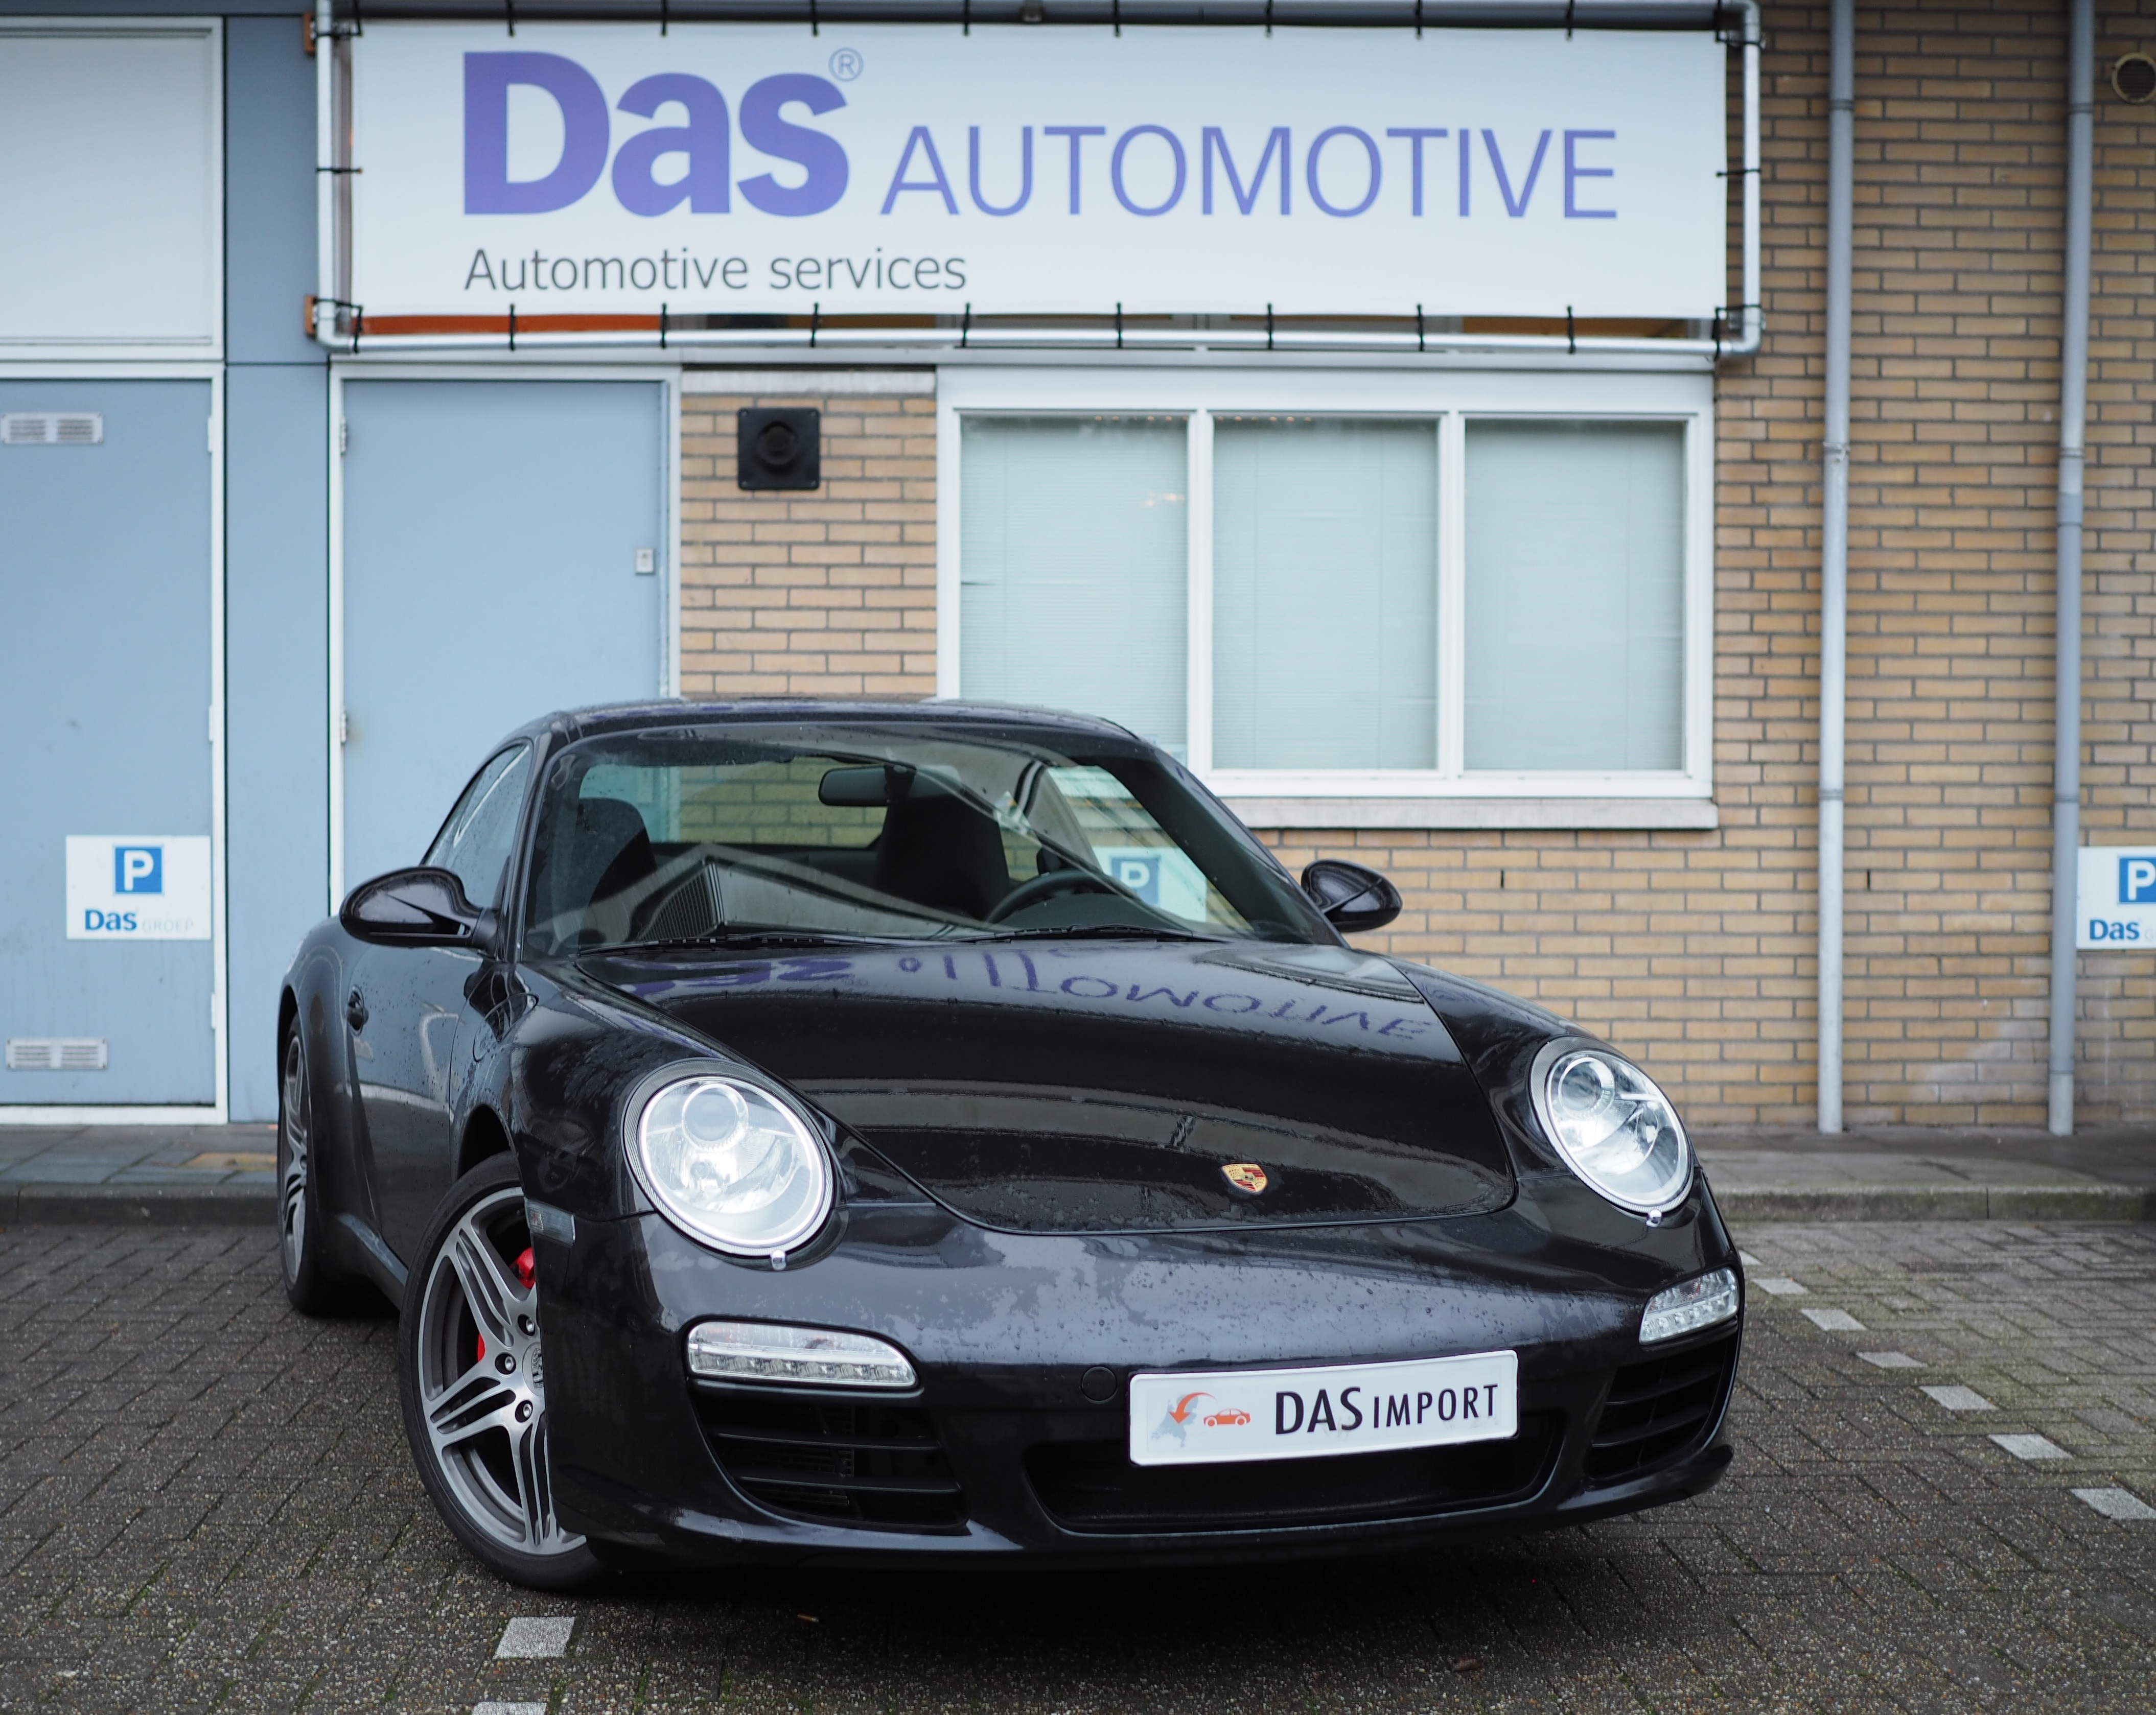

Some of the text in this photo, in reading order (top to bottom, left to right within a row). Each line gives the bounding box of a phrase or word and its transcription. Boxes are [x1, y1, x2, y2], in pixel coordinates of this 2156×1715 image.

[463, 51, 849, 217] Das
[880, 125, 1618, 219] AUTOMOTIVE
[464, 248, 967, 291] Automotive services
[124, 850, 154, 891] P
[2127, 860, 2156, 901] P
[84, 908, 137, 931] Das
[2089, 919, 2140, 941] Das
[1274, 1383, 1499, 1435] DAS IMPORT
